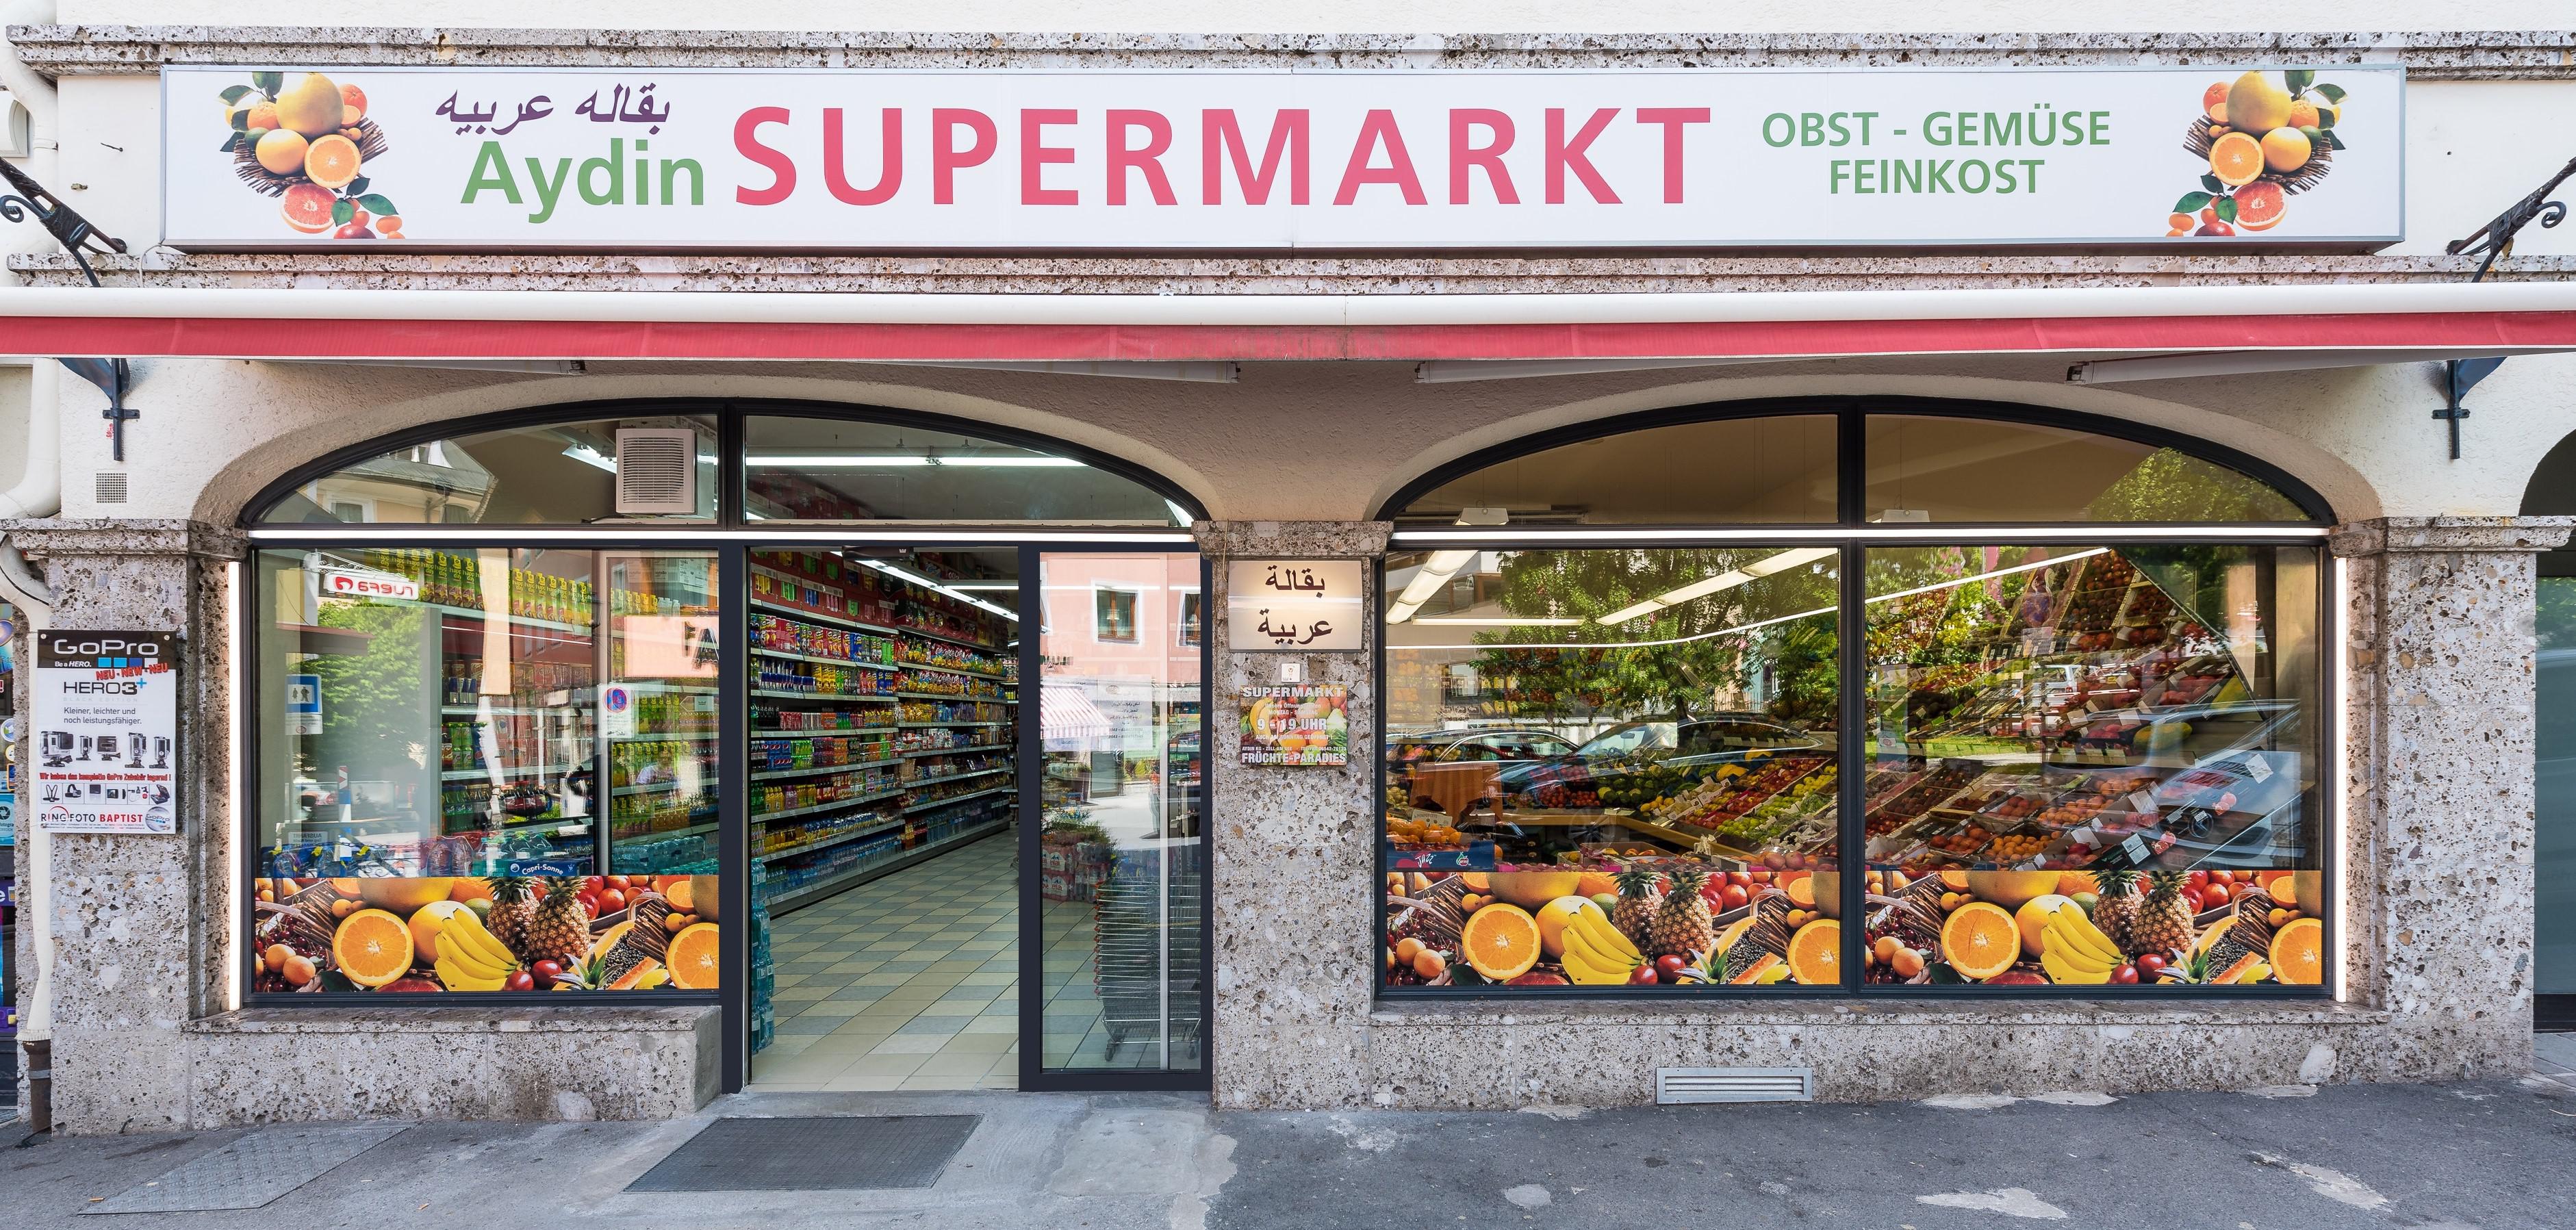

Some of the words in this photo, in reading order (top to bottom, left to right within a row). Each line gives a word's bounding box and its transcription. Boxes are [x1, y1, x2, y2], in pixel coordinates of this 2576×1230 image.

[435, 90, 554, 136] عربيه
[574, 82, 669, 136] بقاله
[1762, 112, 1879, 148] OBST
[1922, 103, 2110, 147] GEMÜSE
[733, 106, 1711, 206] SUPERMARKT
[460, 137, 704, 224] Aydin
[1831, 159, 2045, 194] FEINKOST
[1265, 565, 1325, 599] بقالة
[1257, 608, 1334, 645] عربية
[54, 639, 159, 655] GoPro
[96, 670, 115, 680] NEU
[120, 666, 143, 678] NEW
[149, 663, 168, 674] NEU
[1242, 687, 1343, 697] SUPERMARKT
[83, 717, 142, 726] leistungsfähiger.
[1257, 719, 1265, 730] 9
[1280, 719, 1297, 730] 19
[1301, 719, 1327, 730] UHR
[1242, 752, 1346, 763] FRÜCHTE-PARADIES
[99, 814, 143, 822] BAPTIST
[522, 863, 563, 875] Capri-Sonne
